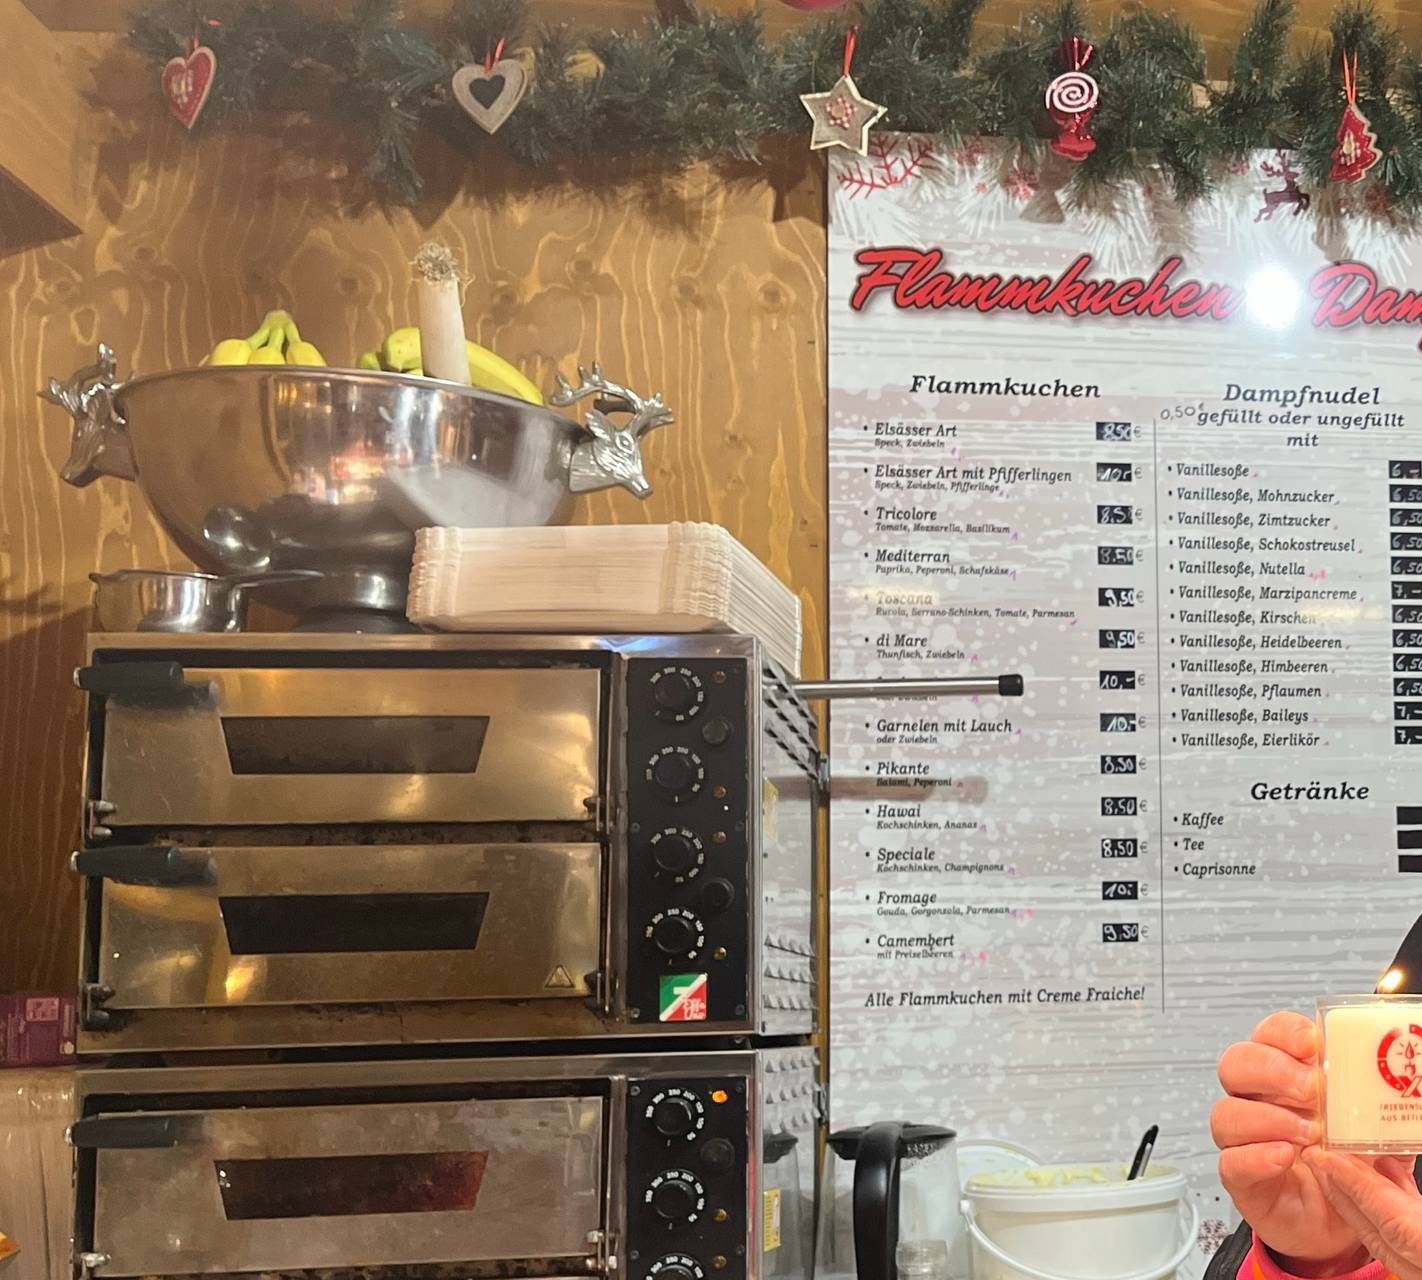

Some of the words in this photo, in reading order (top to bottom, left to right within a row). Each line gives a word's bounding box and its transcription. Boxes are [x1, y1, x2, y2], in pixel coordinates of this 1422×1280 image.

[850, 245, 1246, 319] Flammkuchen
[909, 375, 1101, 398] Flammkuchen
[1223, 384, 1380, 408] Dampfnudel
[1198, 409, 1262, 428] gefüllt
[1268, 412, 1310, 426] oder
[1318, 411, 1404, 429] ungefüllt
[875, 422, 932, 438] Elsässer
[936, 424, 957, 437] Art
[1287, 433, 1319, 447] mit
[875, 466, 932, 479] Elsässer
[936, 467, 958, 479] Art
[962, 468, 984, 480] mit
[988, 467, 1072, 484] Pfifferlingen
[1176, 464, 1249, 478] Vanillesoße
[1177, 488, 1254, 503] Vanillesoße,
[1258, 490, 1334, 503] Mohnzucker
[876, 507, 937, 521] Tricolore
[1178, 512, 1254, 527] Vanillesoße,
[1258, 514, 1330, 527] Zimtzucker
[1178, 538, 1254, 552] Vanillesoße,
[1259, 538, 1356, 552] Schokostreusel
[875, 550, 950, 563] Mediterran
[1179, 586, 1256, 601] Vanillesoße,
[1260, 587, 1357, 602] Marzipancreme
[876, 634, 889, 647] di
[895, 634, 927, 647] Mare
[1180, 660, 1256, 674] Vanillesoße,
[1262, 661, 1328, 673] Himbeeren
[1181, 710, 1257, 724] Vanillesoße,
[1262, 710, 1309, 724] Baileys
[877, 719, 939, 733] Garnelen
[944, 720, 967, 732] mit
[971, 719, 1012, 732] Lauch
[1181, 734, 1258, 748] Vanillesoße,
[1262, 734, 1320, 747] Eierlikör
[877, 762, 929, 775] Pikante
[1250, 782, 1369, 800] Getränke
[877, 805, 921, 817] Hawai
[1182, 813, 1224, 828] Kaffee
[1183, 839, 1204, 850] Tee
[877, 848, 935, 862] Speciale
[1183, 863, 1256, 878] Caprisonne
[877, 891, 936, 907] Fromage
[877, 934, 954, 947] Camembert
[865, 993, 894, 1007] Alle
[899, 991, 1003, 1007] Flammkuchen
[1008, 990, 1031, 1004] mit
[1037, 989, 1081, 1003] Creme
[1086, 986, 1145, 1001] Fraiche!
